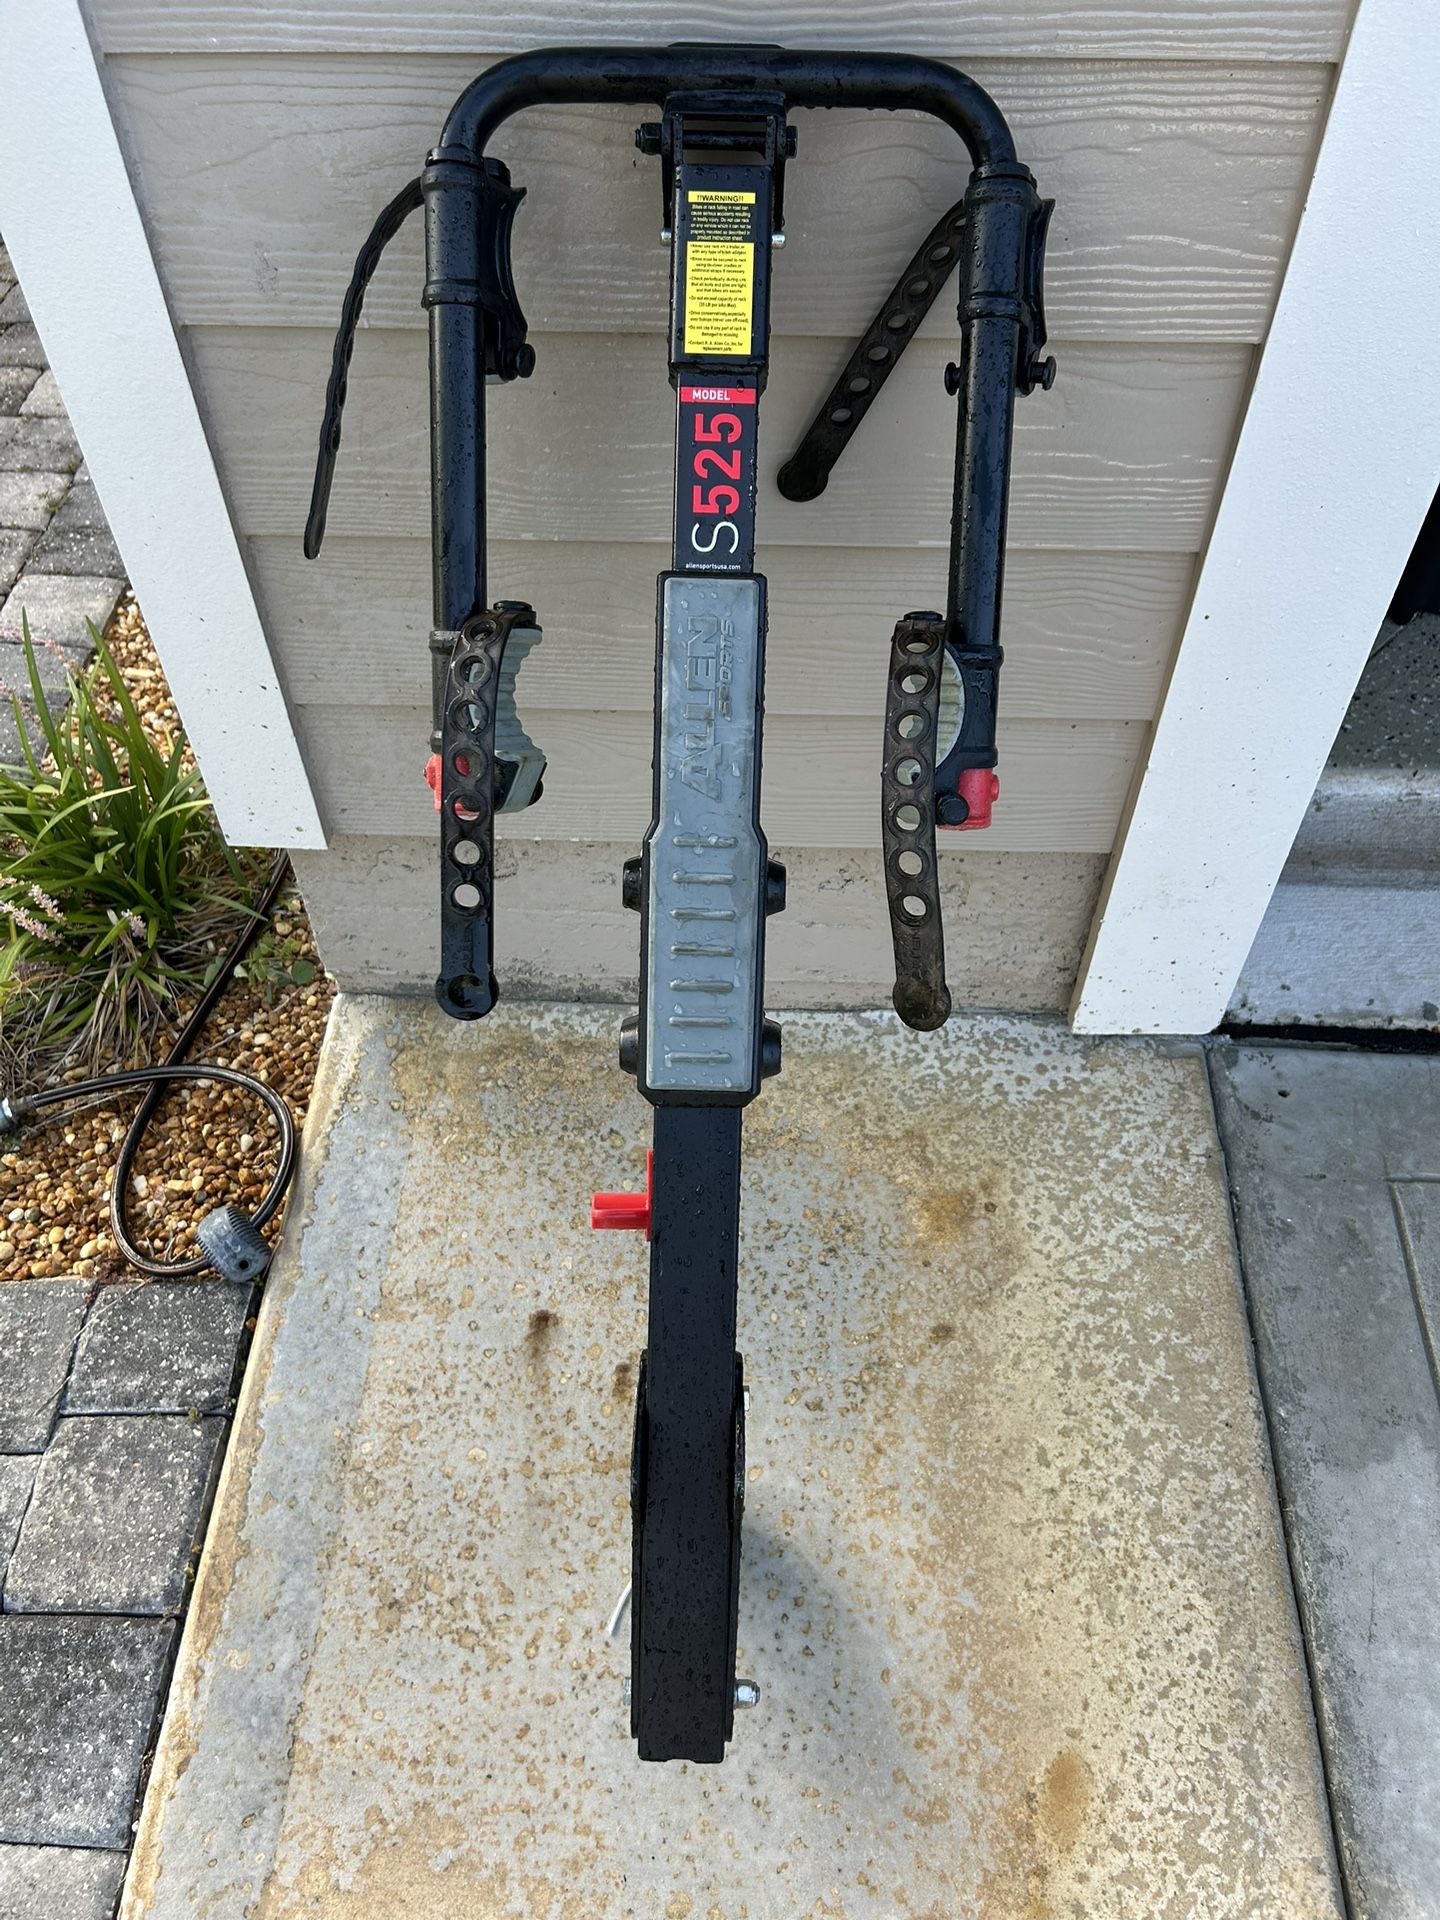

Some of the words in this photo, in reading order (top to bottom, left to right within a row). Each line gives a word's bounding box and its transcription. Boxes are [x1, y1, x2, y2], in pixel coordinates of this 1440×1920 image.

[692, 389, 731, 401] MODEL
[691, 413, 743, 554] S525
[685, 562, 741, 570] allensportsusa.com
[681, 615, 722, 803] ALLEN
[718, 618, 735, 721] SPORTS
